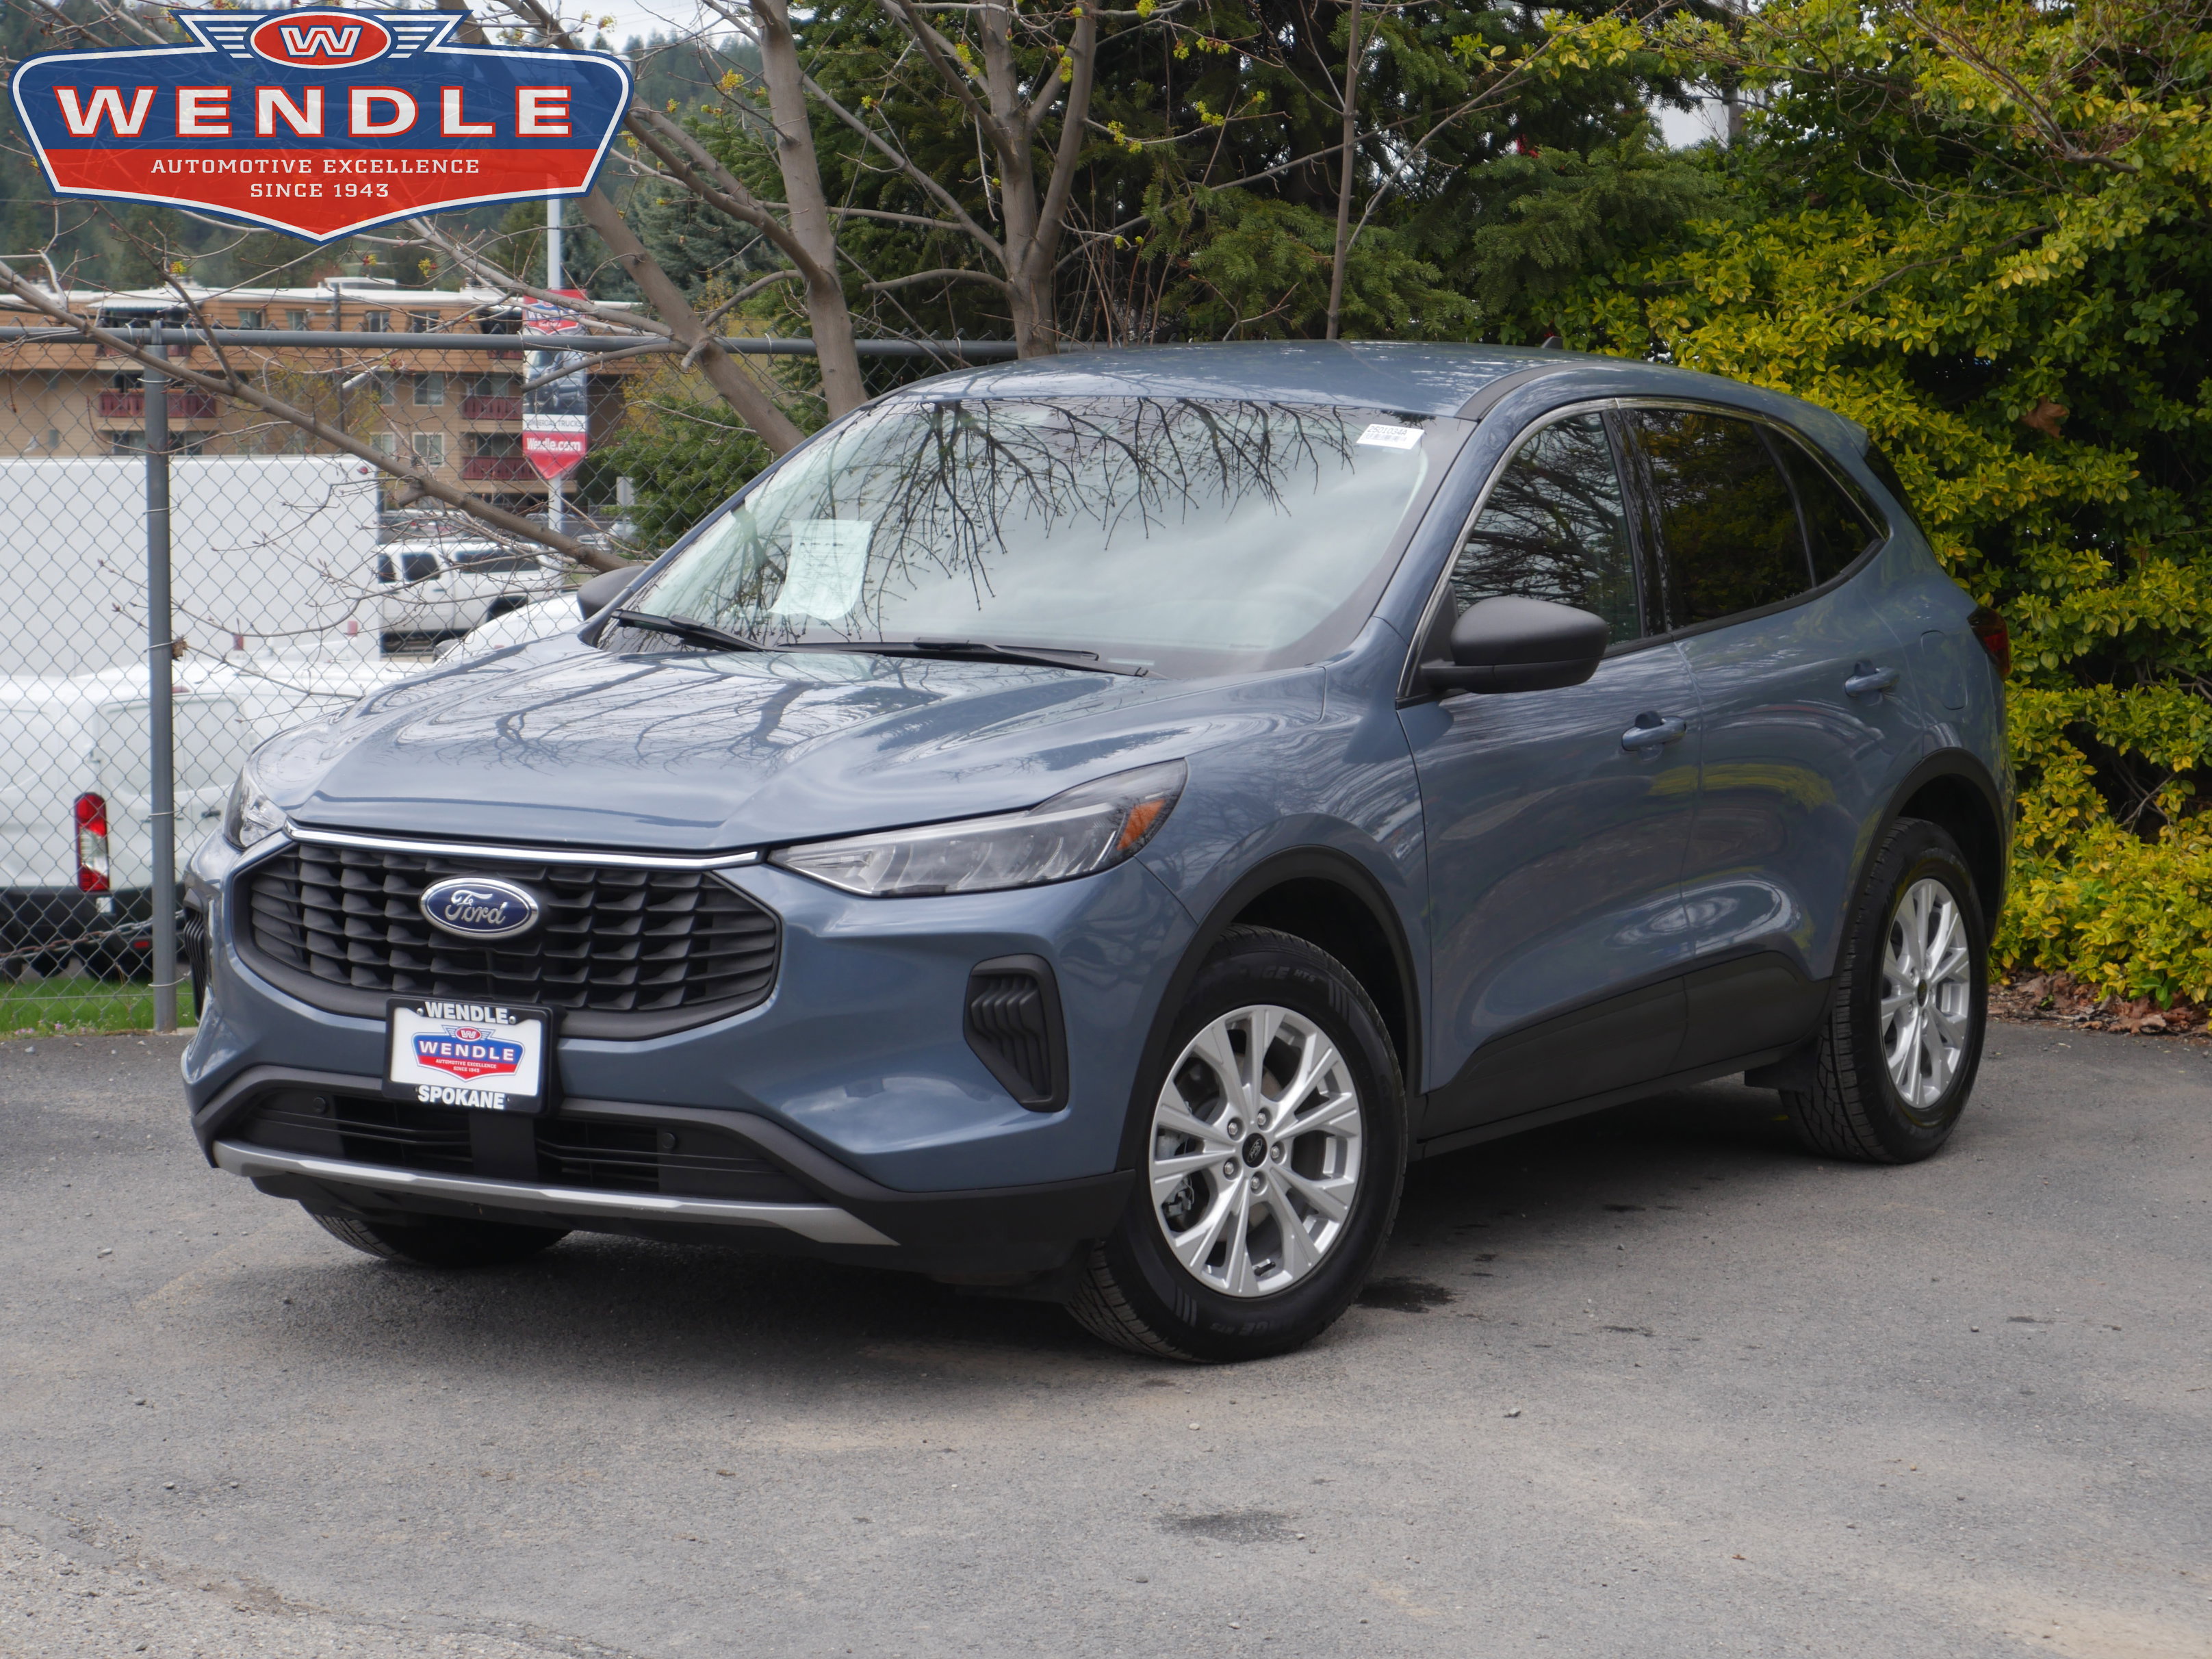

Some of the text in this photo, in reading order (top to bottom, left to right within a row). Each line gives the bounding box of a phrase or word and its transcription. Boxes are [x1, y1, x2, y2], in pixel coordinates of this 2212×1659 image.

[526, 437, 581, 451] Wendle.com
[445, 889, 506, 925] Ford
[424, 1001, 509, 1025] WENDLE
[419, 1040, 515, 1062] WENDLE
[417, 1085, 505, 1110] SPOKANE
